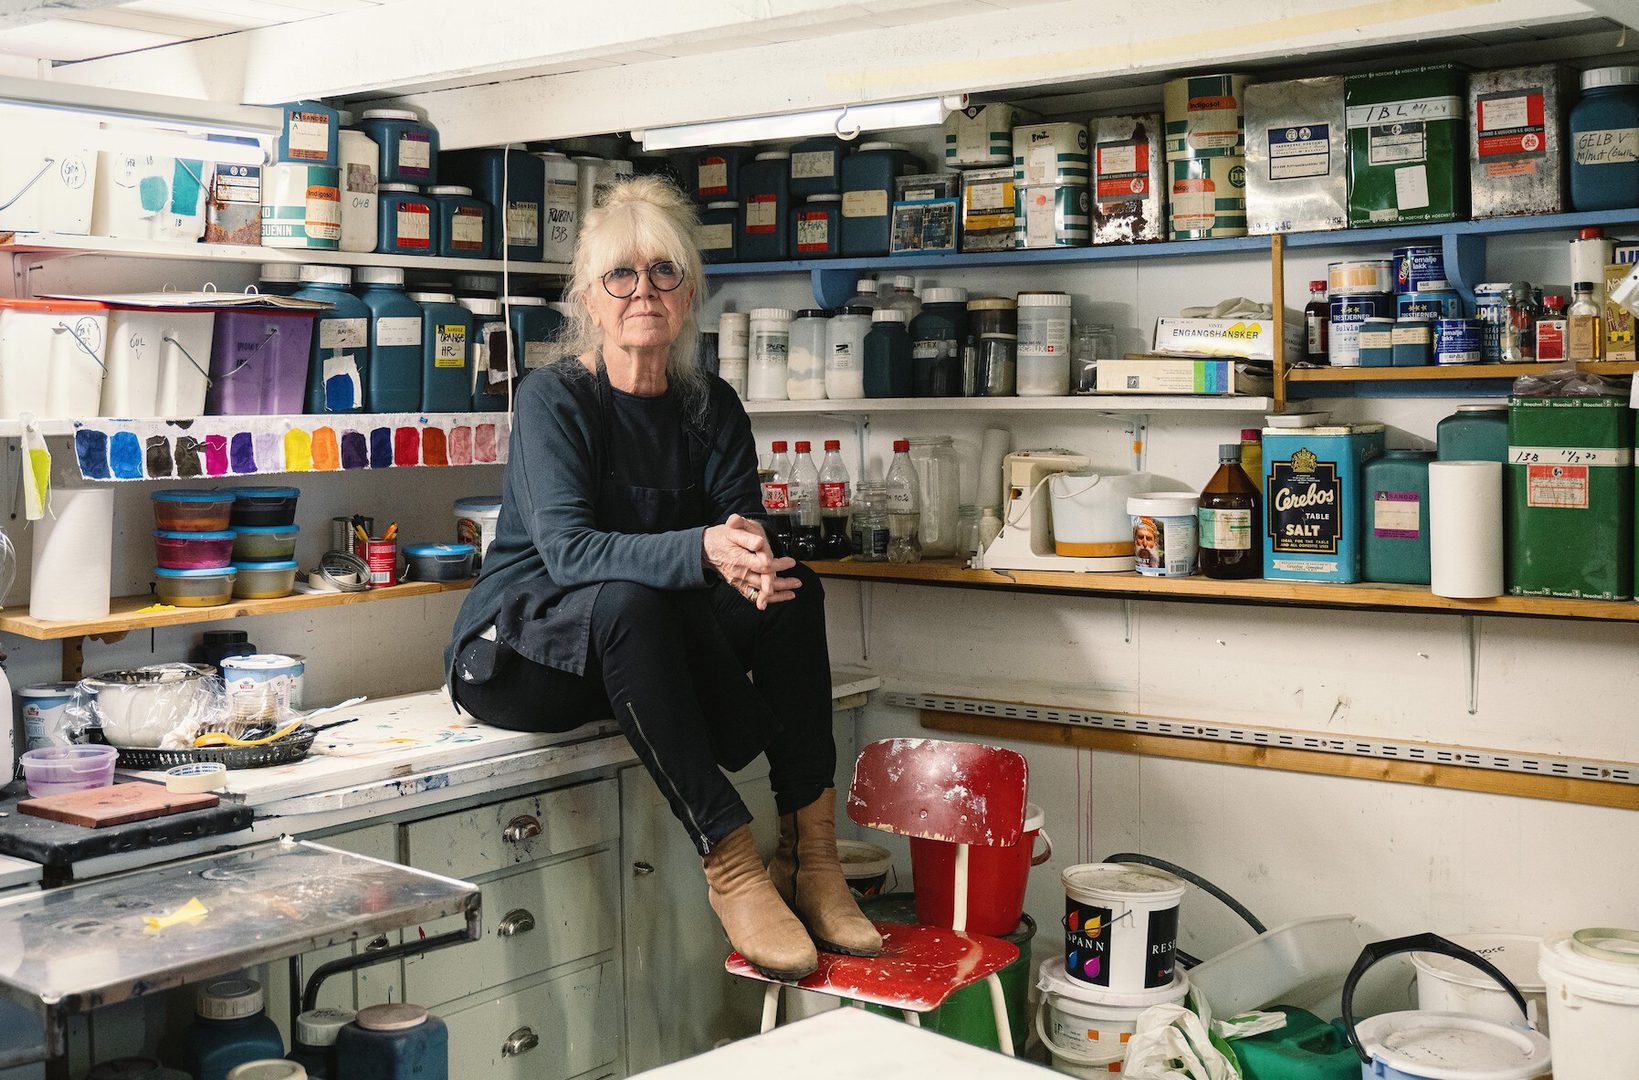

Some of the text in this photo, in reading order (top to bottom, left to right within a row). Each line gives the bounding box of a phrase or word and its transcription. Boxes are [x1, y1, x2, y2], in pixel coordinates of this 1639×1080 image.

[302, 113, 328, 123] SANDOZ
[1579, 132, 1613, 150] GELB
[1414, 256, 1437, 264] emalje
[1172, 328, 1260, 340] ENGANGSHANSKER
[1275, 482, 1335, 512] Cerebos
[1388, 493, 1419, 501] SANDOZ
[1305, 512, 1330, 521] TABLE
[1286, 523, 1321, 537] SALT
[1068, 932, 1105, 952] SPANN
[1151, 938, 1177, 955] RESE
